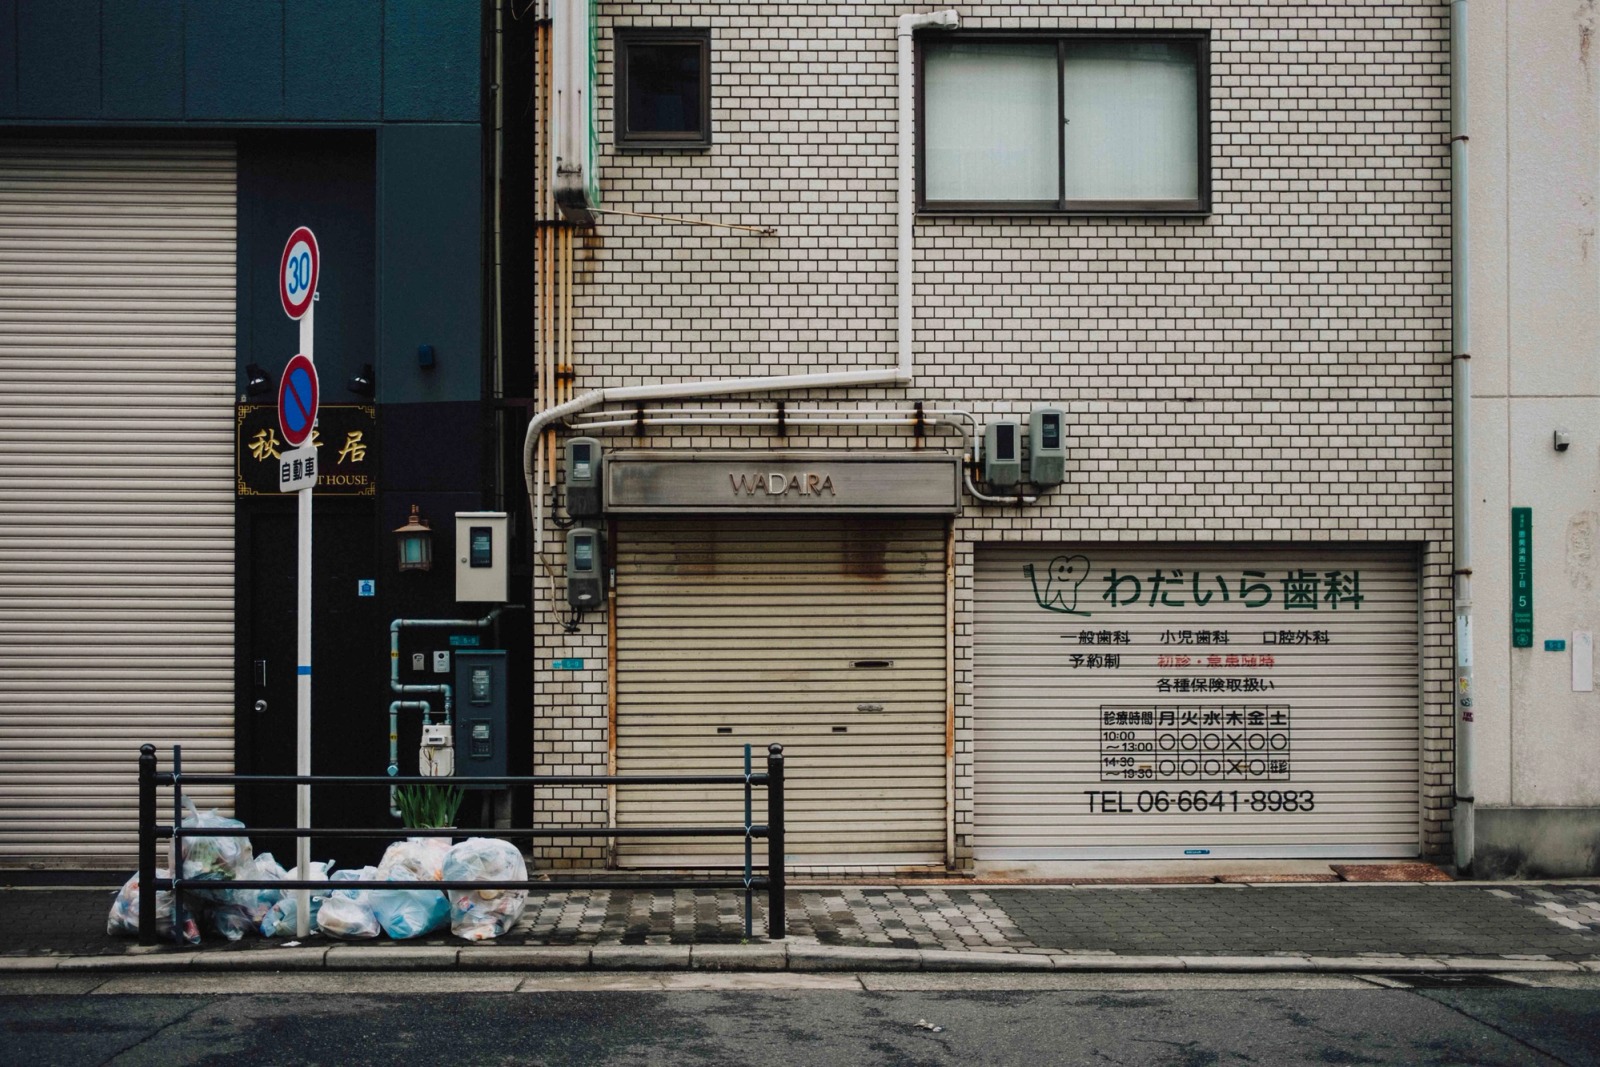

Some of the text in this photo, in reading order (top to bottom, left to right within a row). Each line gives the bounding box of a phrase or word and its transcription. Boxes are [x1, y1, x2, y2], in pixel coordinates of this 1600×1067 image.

[288, 252, 310, 295] 30
[248, 428, 367, 465] 秋居
[281, 456, 315, 483] 自動車
[327, 474, 368, 485] HOUSE
[729, 472, 836, 497] WADAIRA
[1102, 568, 1364, 610] わだいら歯科
[1519, 596, 1527, 607] 5
[1060, 629, 1330, 646] 一般歯科 小児歯科 口腔外科
[1068, 653, 1121, 669] 予約制
[1156, 678, 1275, 693] 各種保険取扱い
[1103, 710, 1288, 726] 診療時間 月 火 水 木 金 土
[1103, 731, 1136, 741] 10:00
[1103, 757, 1135, 767] 14:30
[1084, 791, 1315, 813] TEL 06-6641-8983
